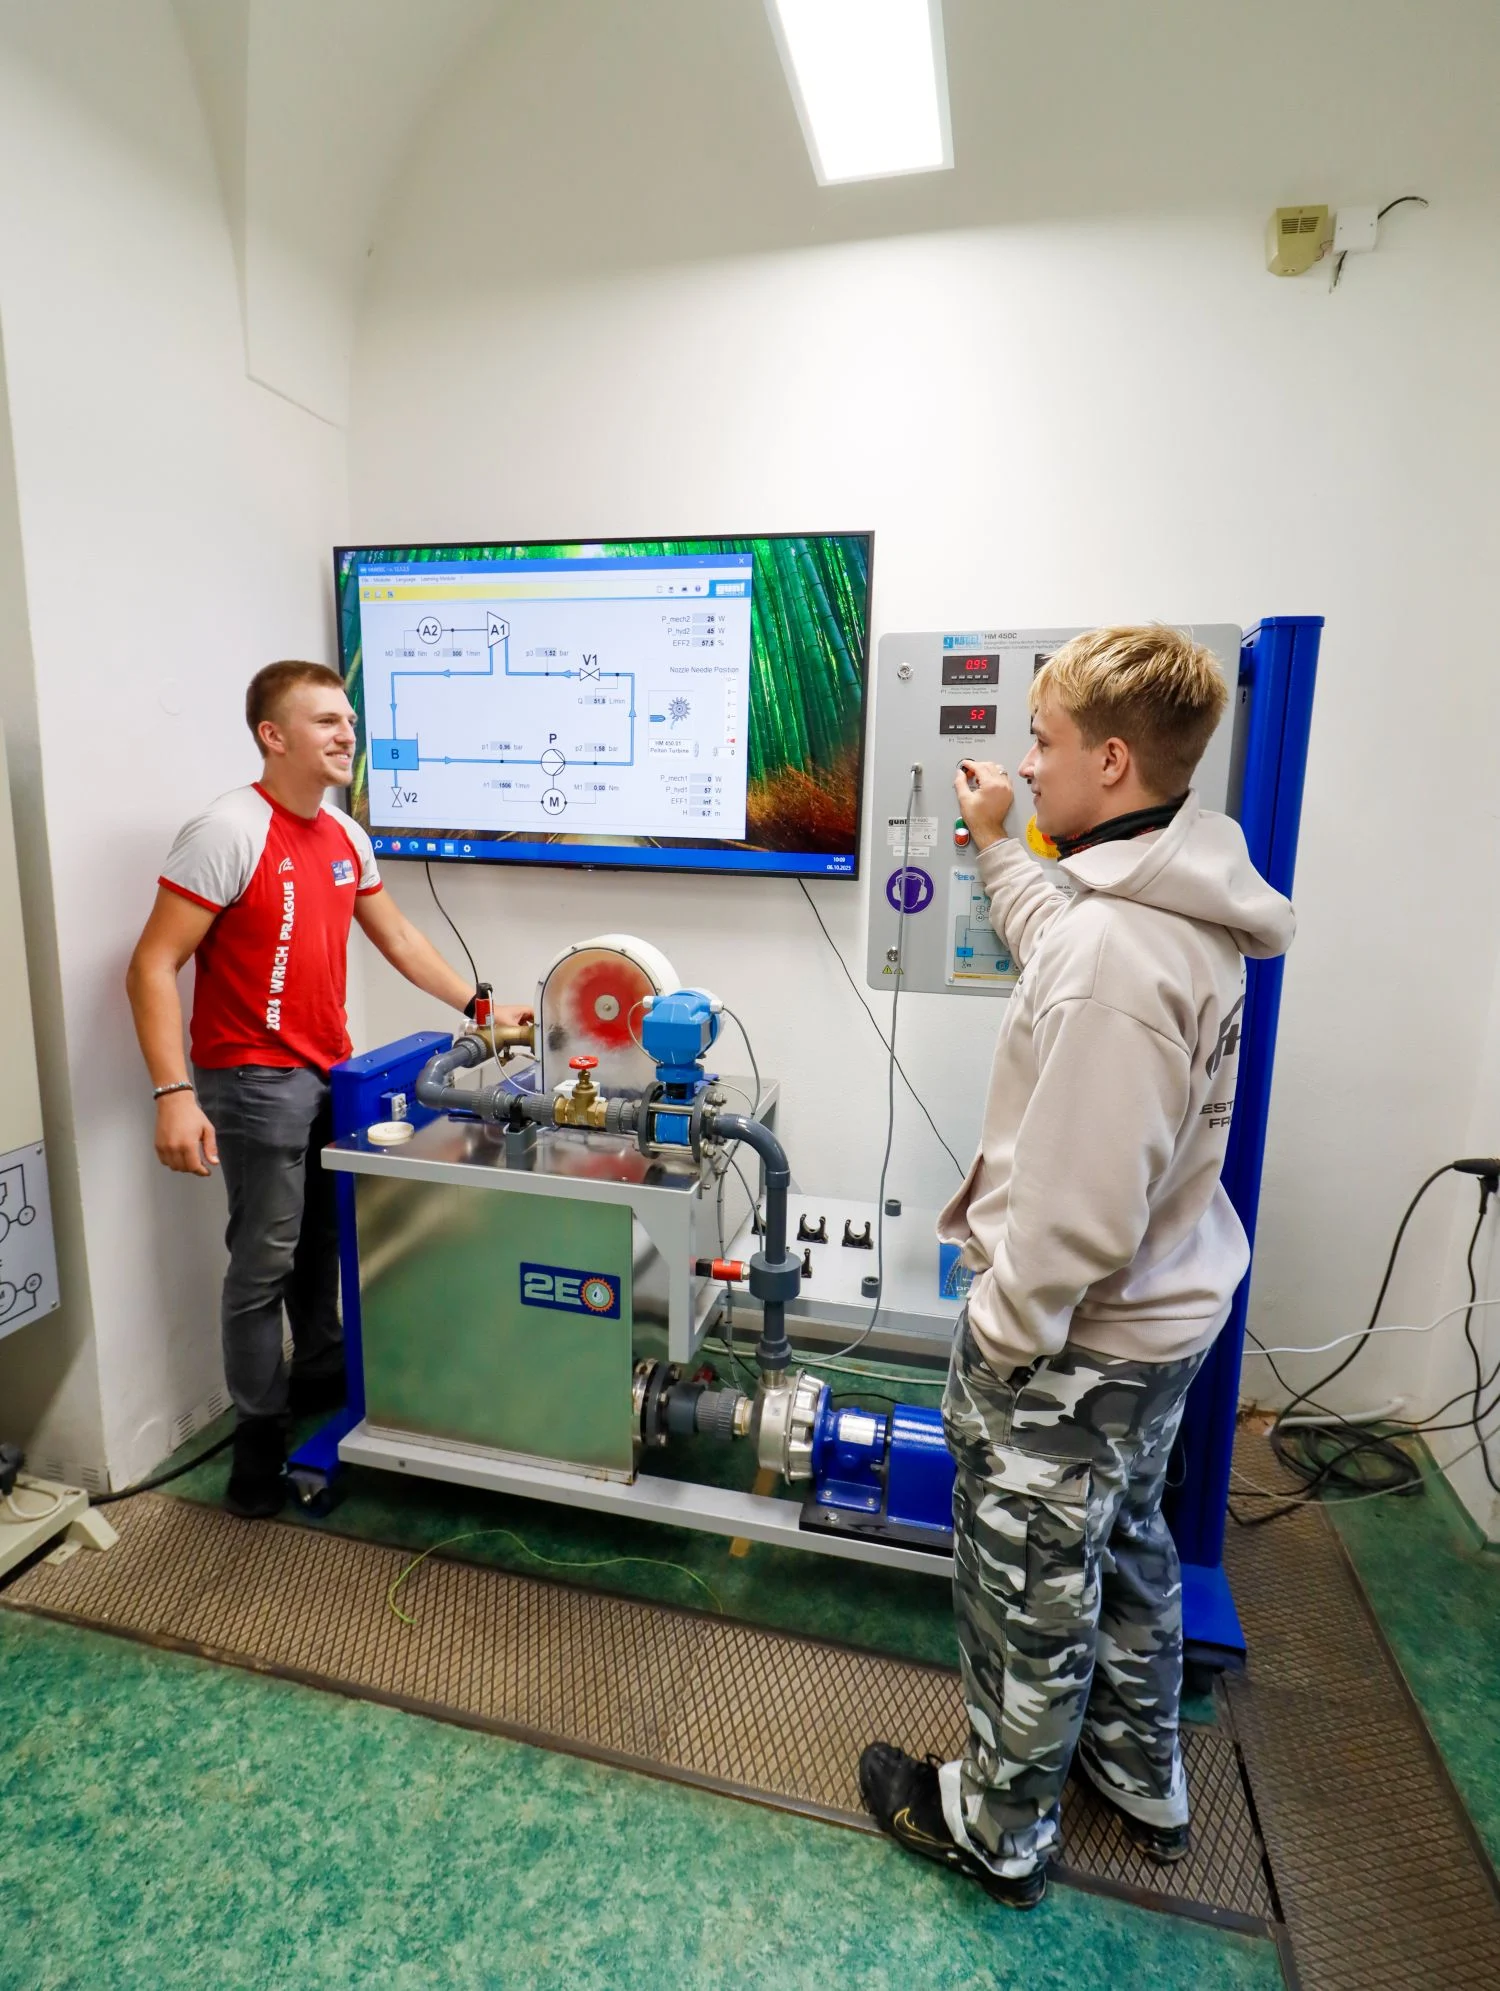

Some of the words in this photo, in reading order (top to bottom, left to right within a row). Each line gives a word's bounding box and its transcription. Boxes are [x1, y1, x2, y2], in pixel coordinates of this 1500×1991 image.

[662, 616, 690, 624] P_mech2
[422, 624, 438, 636] A2
[490, 624, 506, 636] A1
[668, 628, 690, 636] P_hyd2
[582, 654, 598, 666] V1
[970, 709, 986, 720] 52
[550, 733, 557, 744] P
[392, 749, 400, 760] B
[666, 786, 688, 794] P_hyd1
[404, 792, 418, 803] V2
[550, 796, 560, 808] M
[280, 880, 294, 941] PRAGUE
[270, 944, 290, 994] WRICH
[266, 998, 281, 1031] 2024
